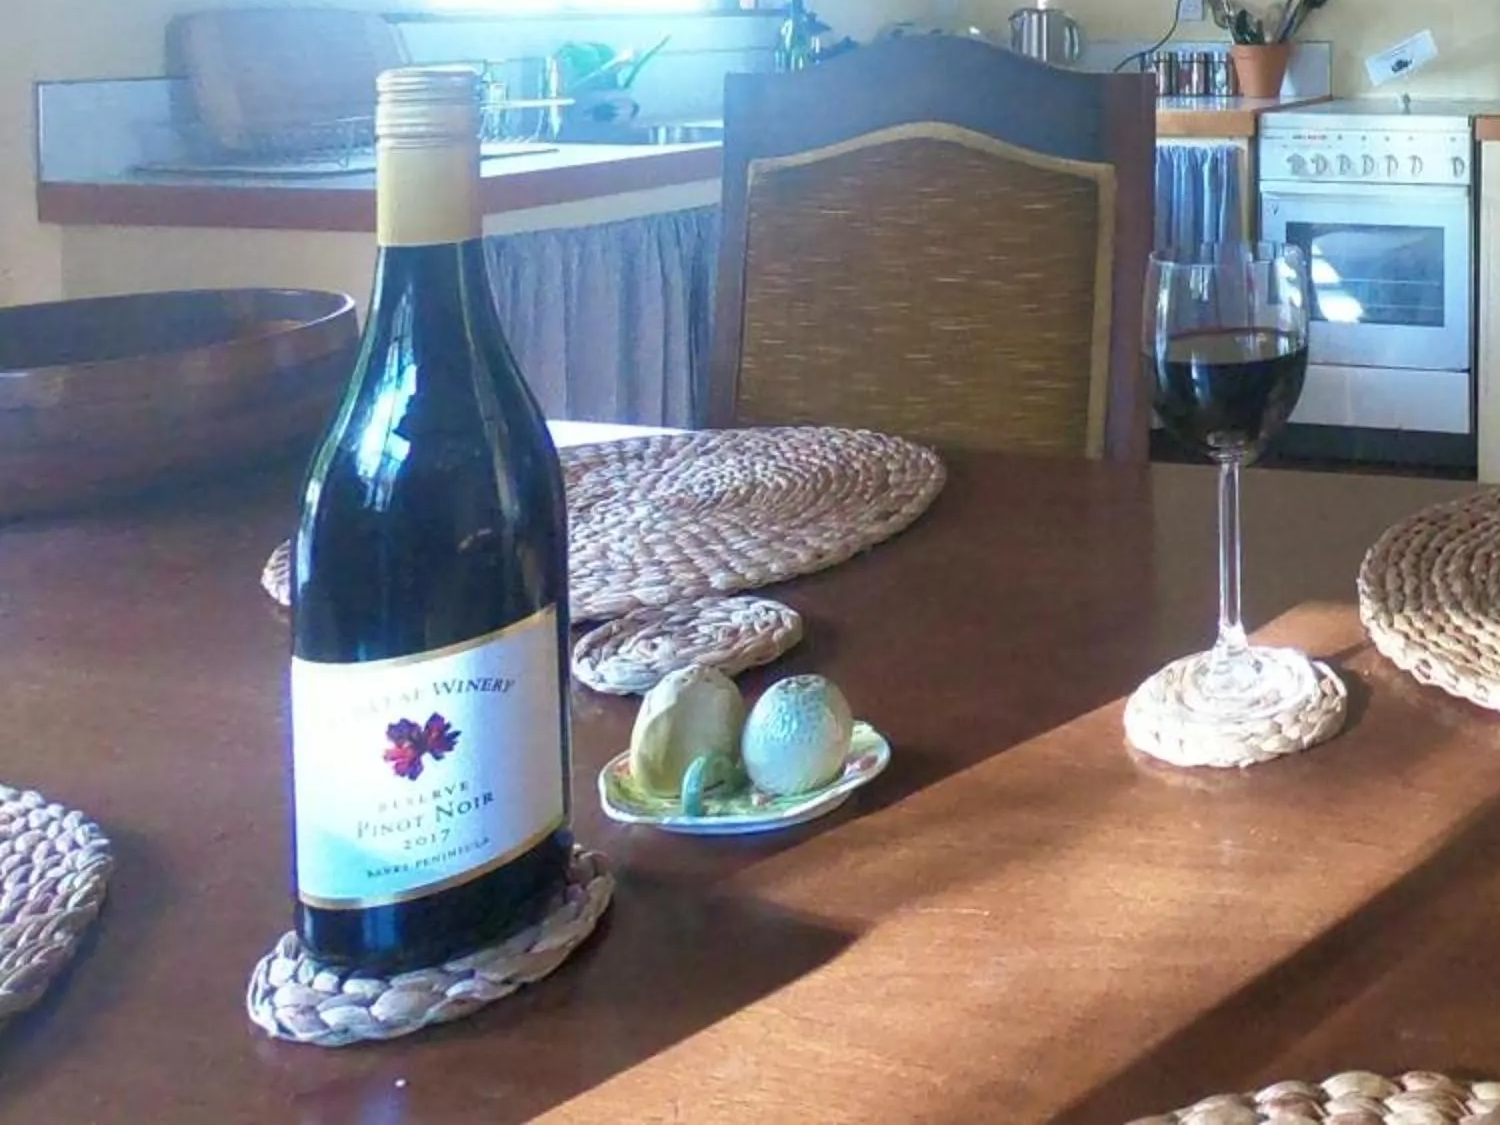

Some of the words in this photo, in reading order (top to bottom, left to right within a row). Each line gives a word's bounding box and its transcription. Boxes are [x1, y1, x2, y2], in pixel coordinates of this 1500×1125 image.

[432, 676, 516, 696] WINERY
[357, 814, 425, 839] PINOT
[435, 791, 495, 823] NOIR
[403, 827, 451, 850] 2017
